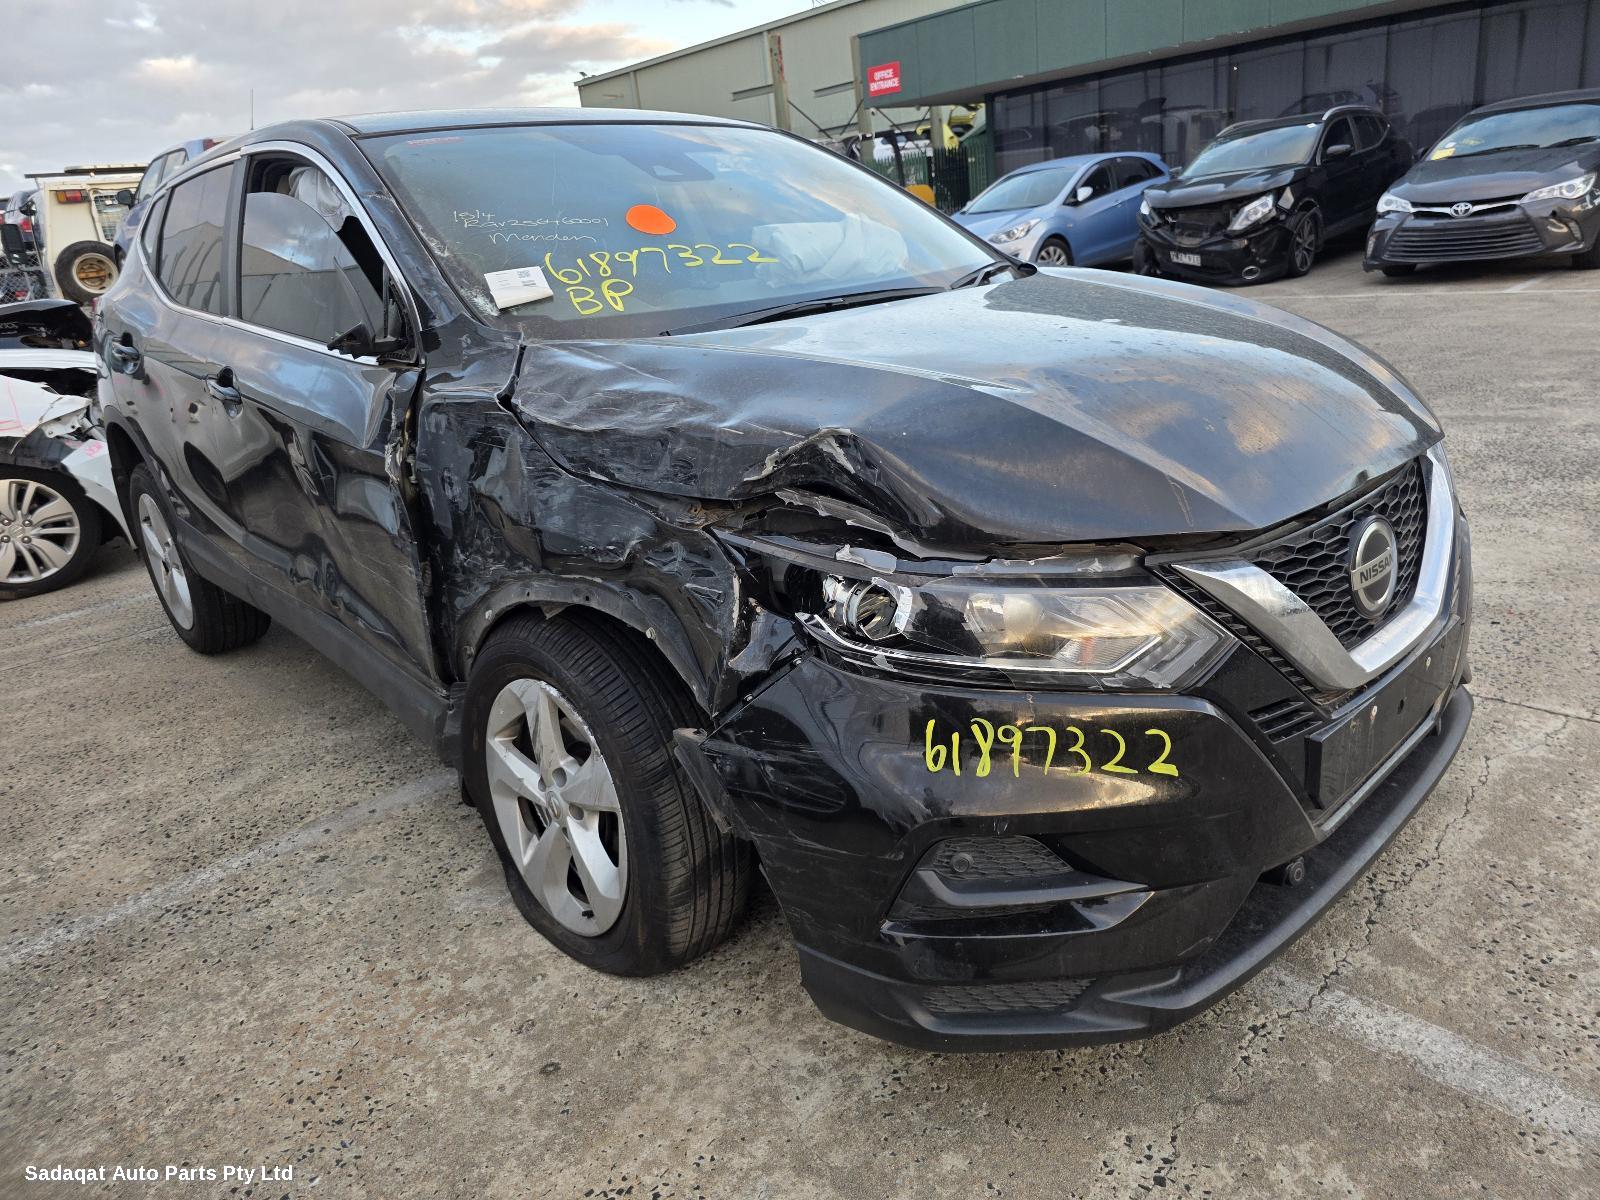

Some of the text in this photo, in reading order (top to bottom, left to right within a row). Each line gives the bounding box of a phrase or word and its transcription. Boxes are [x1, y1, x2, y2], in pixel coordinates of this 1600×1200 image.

[870, 77, 900, 91] ENTRANCE
[874, 69, 893, 80] OFFICE
[545, 244, 779, 284] 61897322
[925, 717, 1179, 778] 61897322
